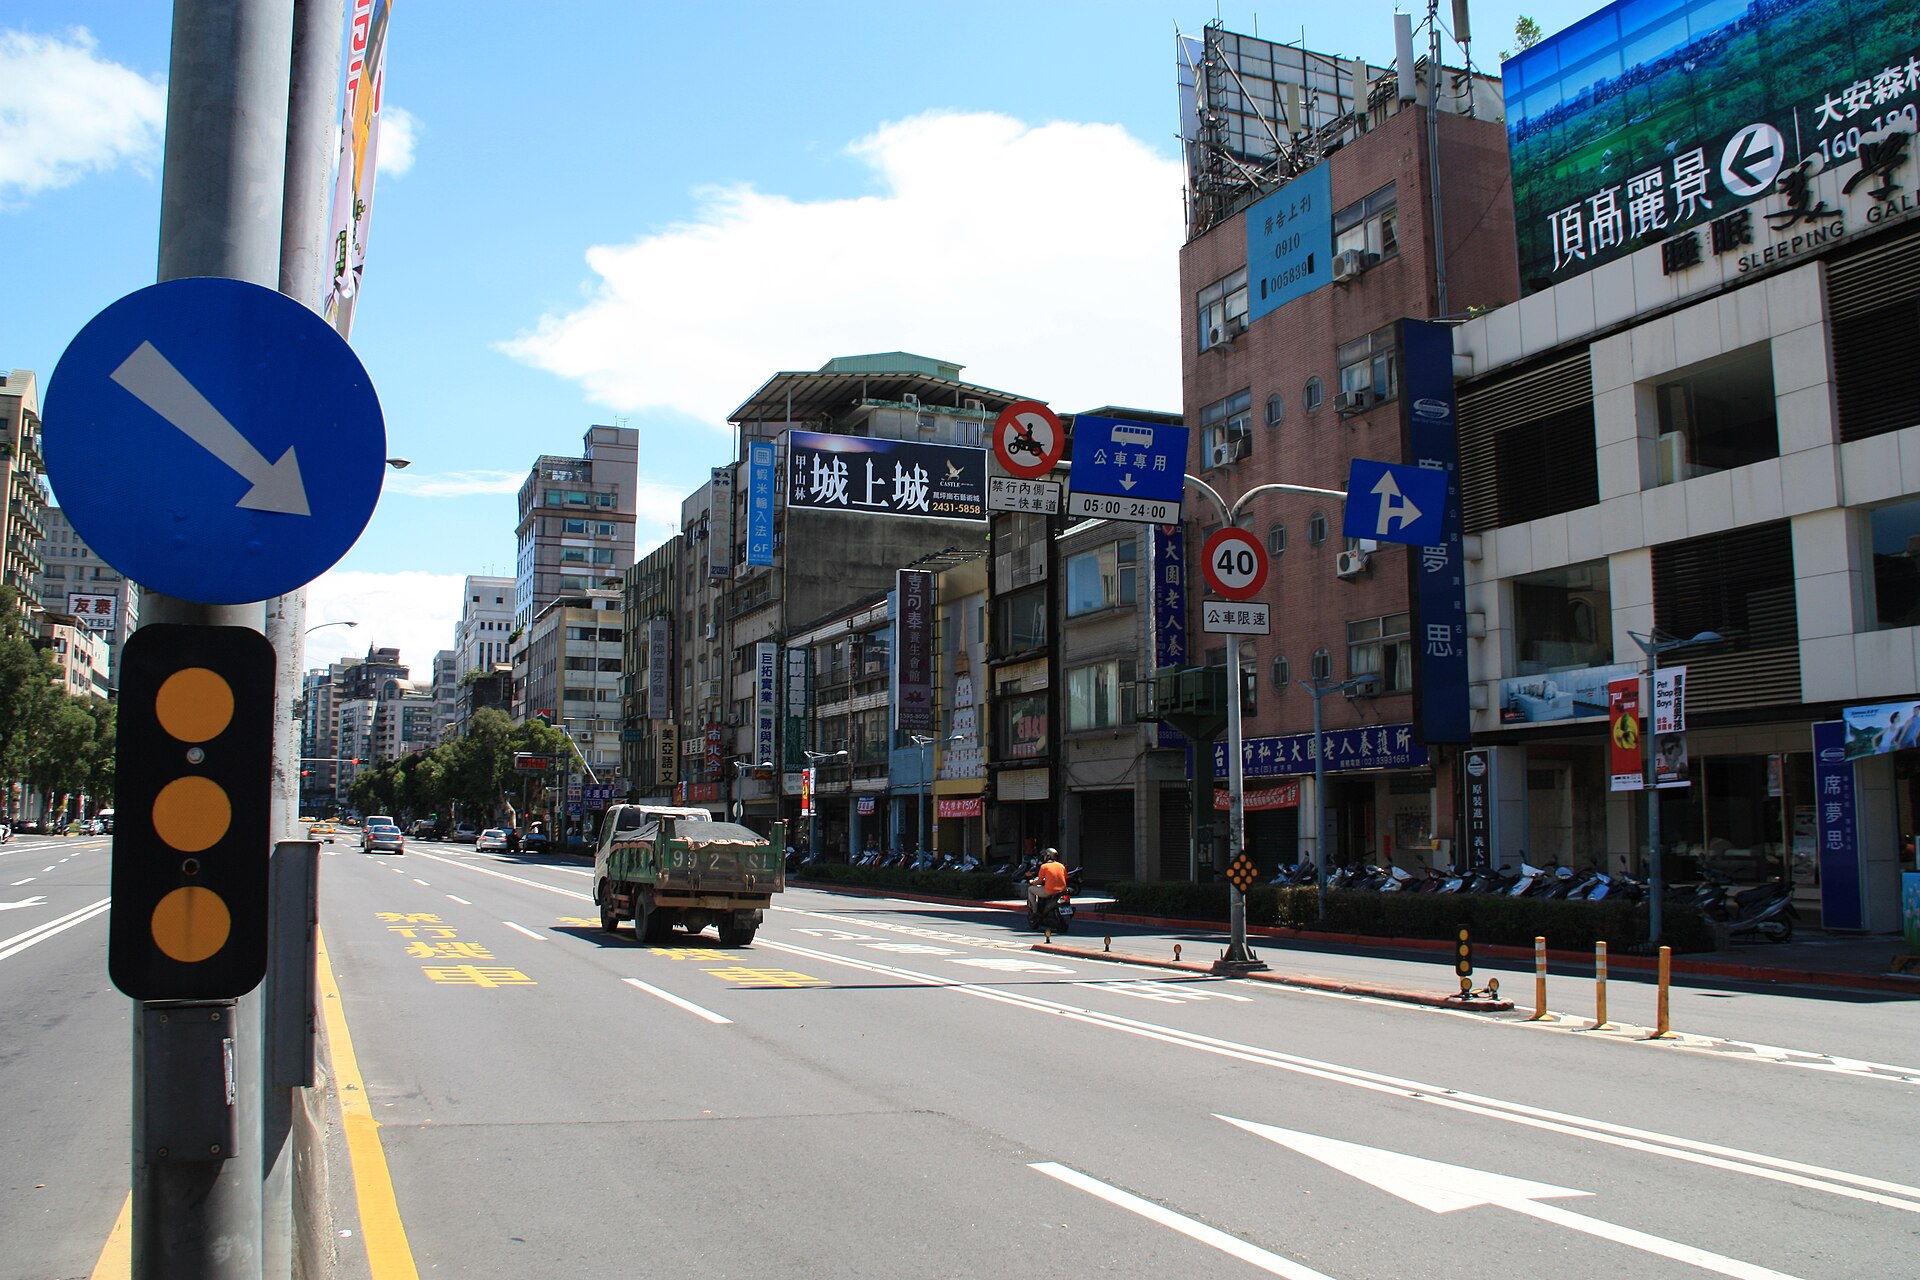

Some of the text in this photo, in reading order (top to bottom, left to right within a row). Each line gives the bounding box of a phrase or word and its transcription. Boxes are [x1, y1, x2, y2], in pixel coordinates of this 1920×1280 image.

[1264, 194, 1311, 236] 廣告上刊
[1546, 147, 1713, 273] 頂高麗景
[1275, 232, 1300, 259] 0910
[1738, 220, 1844, 273] SLEEPING
[1270, 261, 1307, 293] 005839
[794, 454, 806, 500] 甲山林
[1094, 448, 1167, 472] 公車專用
[810, 453, 930, 512] 城上城
[992, 480, 1058, 495] 禁行內側一
[755, 468, 769, 537] 蝦米輸入法
[932, 502, 981, 514] 2431-5858
[753, 543, 769, 552] 6F
[1217, 550, 1254, 575] 40
[74, 598, 112, 614] 友泰
[1164, 540, 1184, 664] 大園老人養
[1207, 609, 1266, 625] 公車限速
[761, 652, 772, 703] 巨拓實業
[1657, 690, 1673, 698] Shop
[1657, 700, 1672, 708] Boys
[661, 729, 674, 782] 美亞語文
[1215, 728, 1411, 767] 台市私立大園老人養護所
[1824, 774, 1844, 850] 席夢思
[374, 911, 538, 988] 禁行機車
